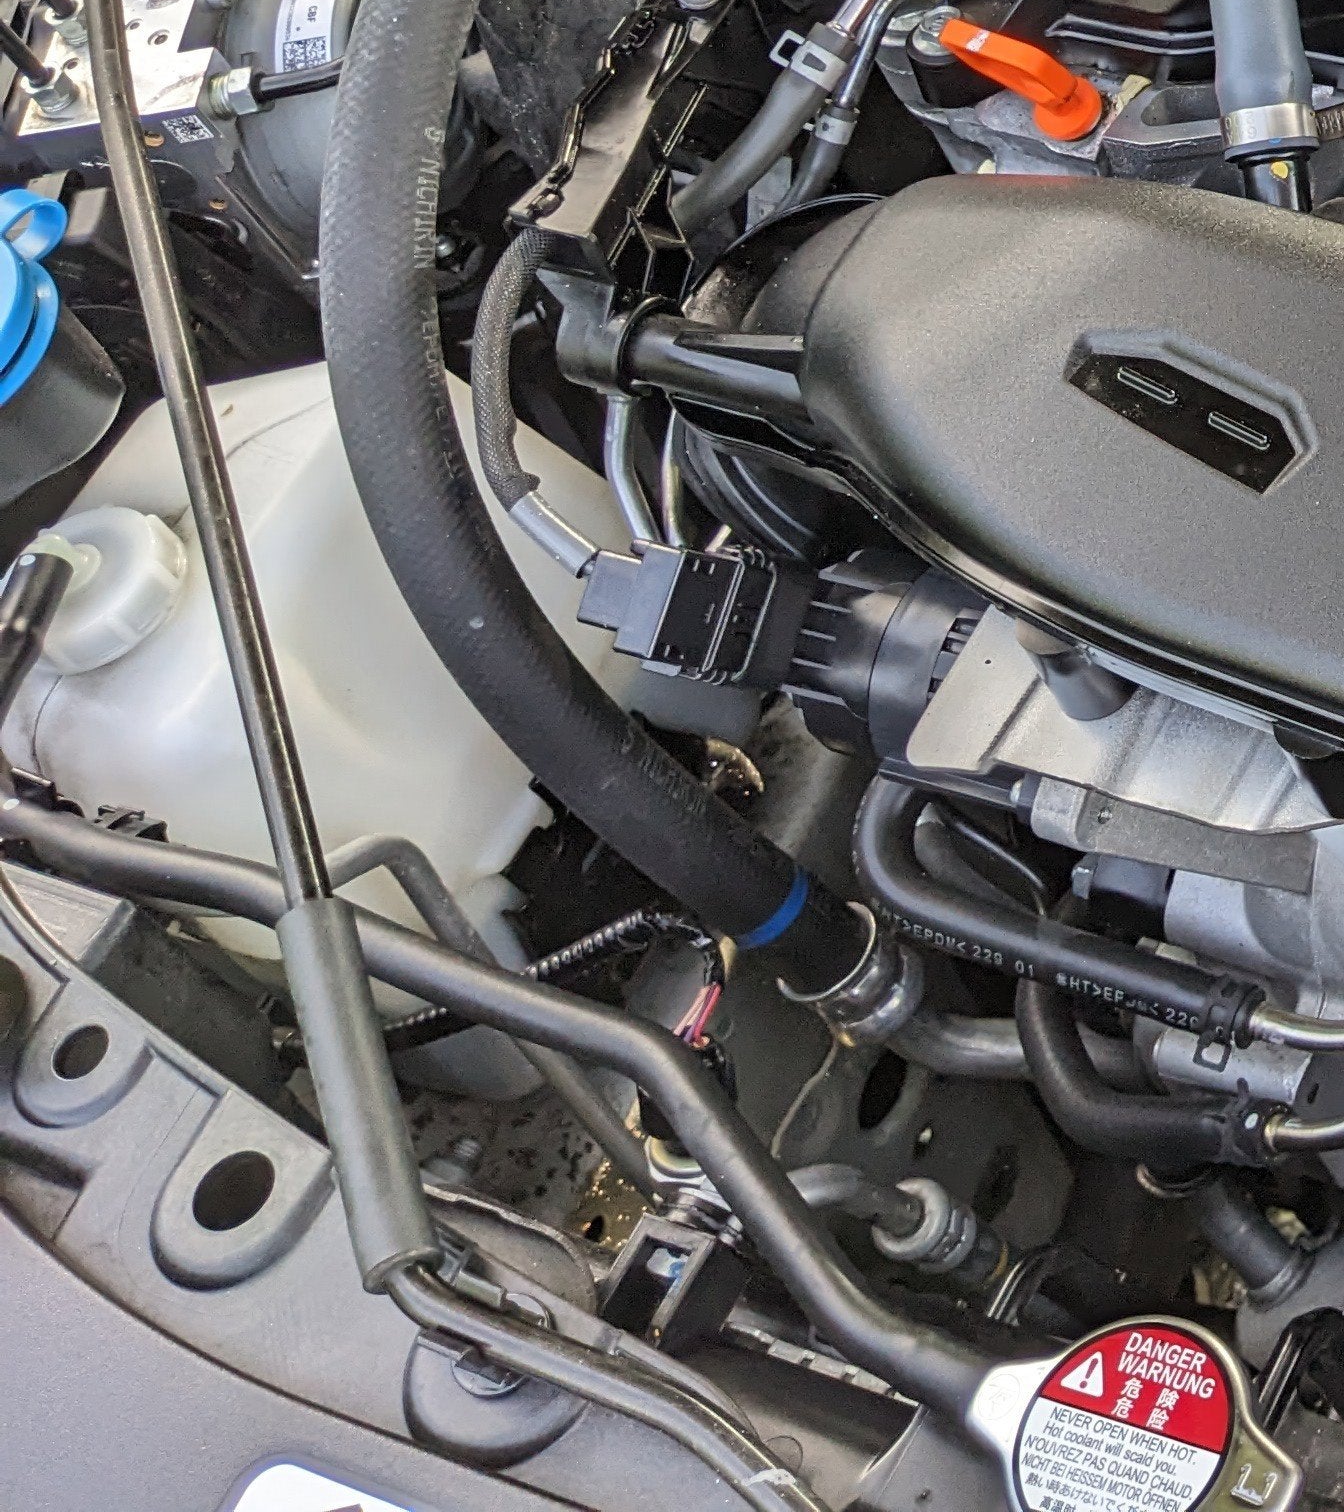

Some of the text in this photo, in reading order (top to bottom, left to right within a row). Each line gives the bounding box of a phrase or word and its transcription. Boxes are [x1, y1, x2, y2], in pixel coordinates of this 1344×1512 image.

[1117, 1351, 1217, 1400] WARNUNG
[1124, 1331, 1208, 1375] DANGER
[1042, 1422, 1177, 1477] Hot coolant will scald you.
[1049, 1405, 1198, 1466] NEVER OPEN WHEN HOT.
[1021, 1452, 1050, 1473] NICHT
[1050, 1461, 1067, 1478] BEI
[1066, 1466, 1109, 1491] HEISSEM
[1107, 1478, 1143, 1502] MOTOR
[1024, 1434, 1193, 1501] N'OUVREZ PAS QUAND CHAUD.
